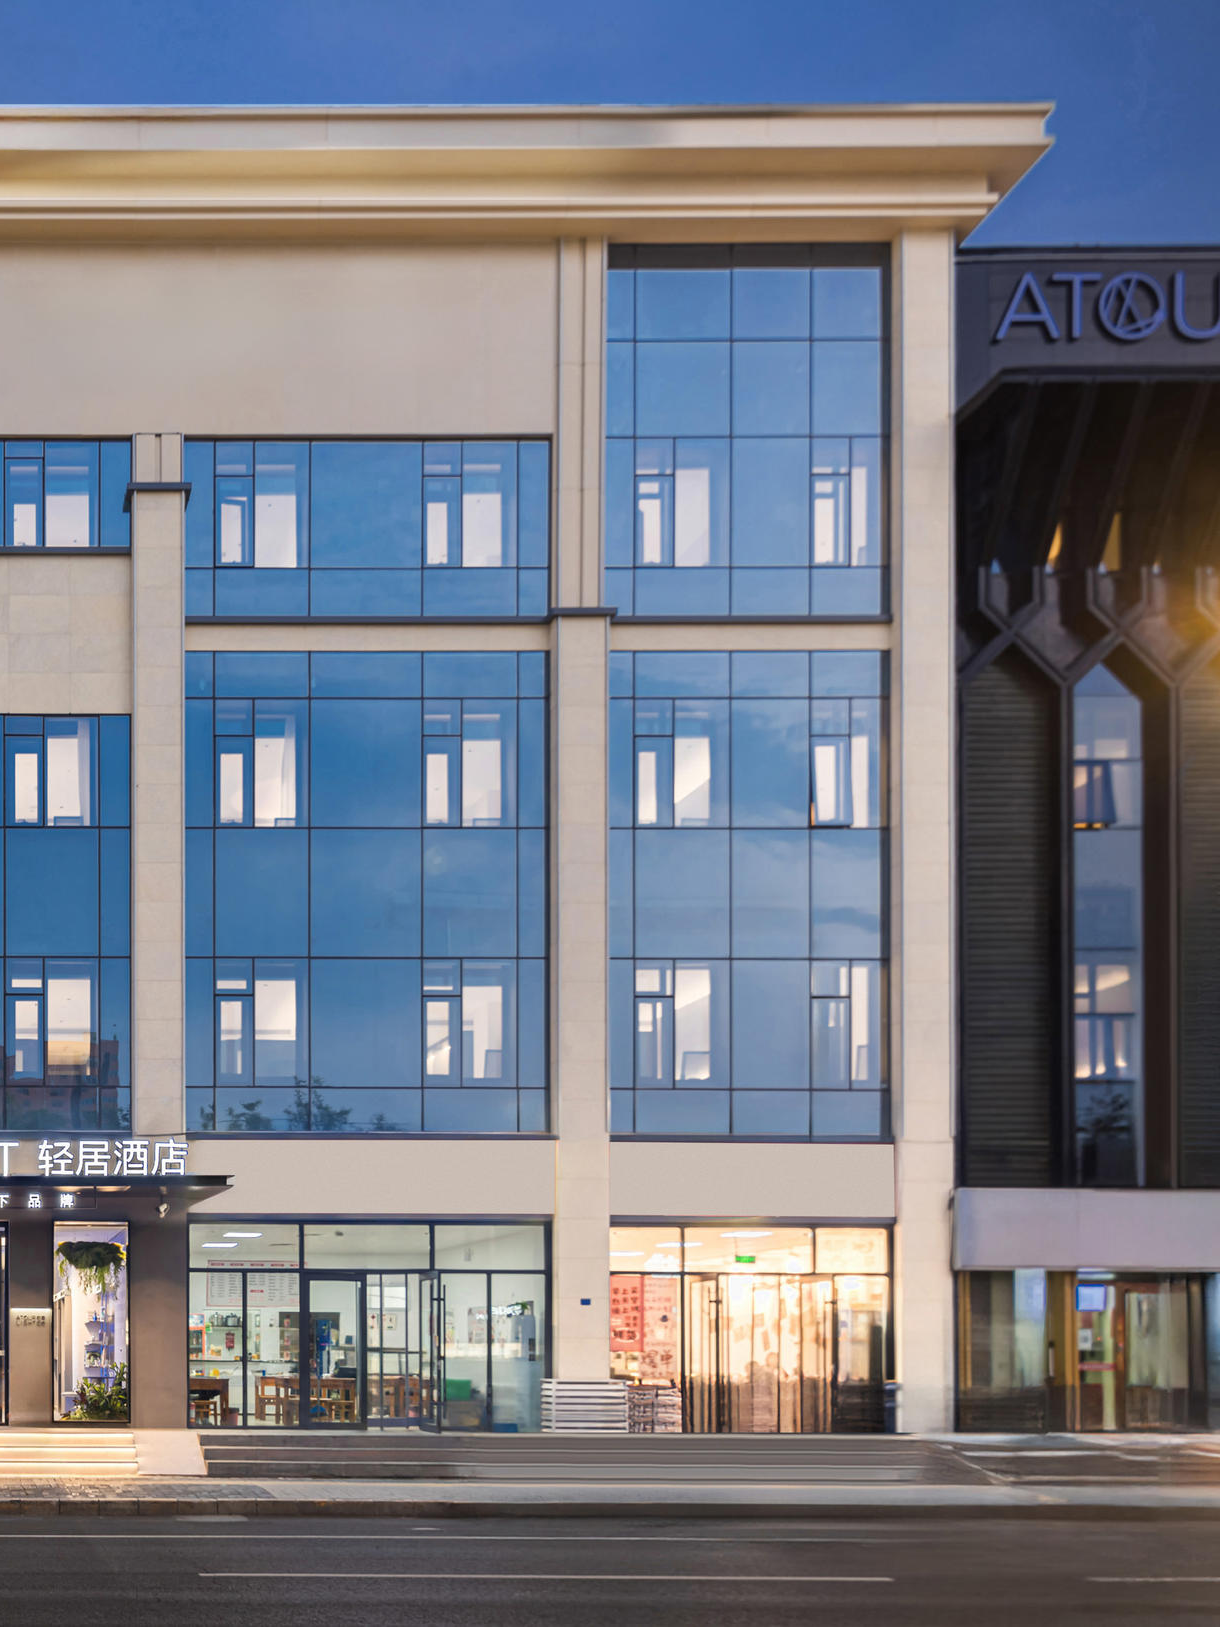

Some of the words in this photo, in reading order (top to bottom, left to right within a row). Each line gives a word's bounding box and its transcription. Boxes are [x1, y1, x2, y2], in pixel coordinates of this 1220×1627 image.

[995, 270, 1220, 341] ATOU
[38, 1137, 189, 1177] 轻居酒店
